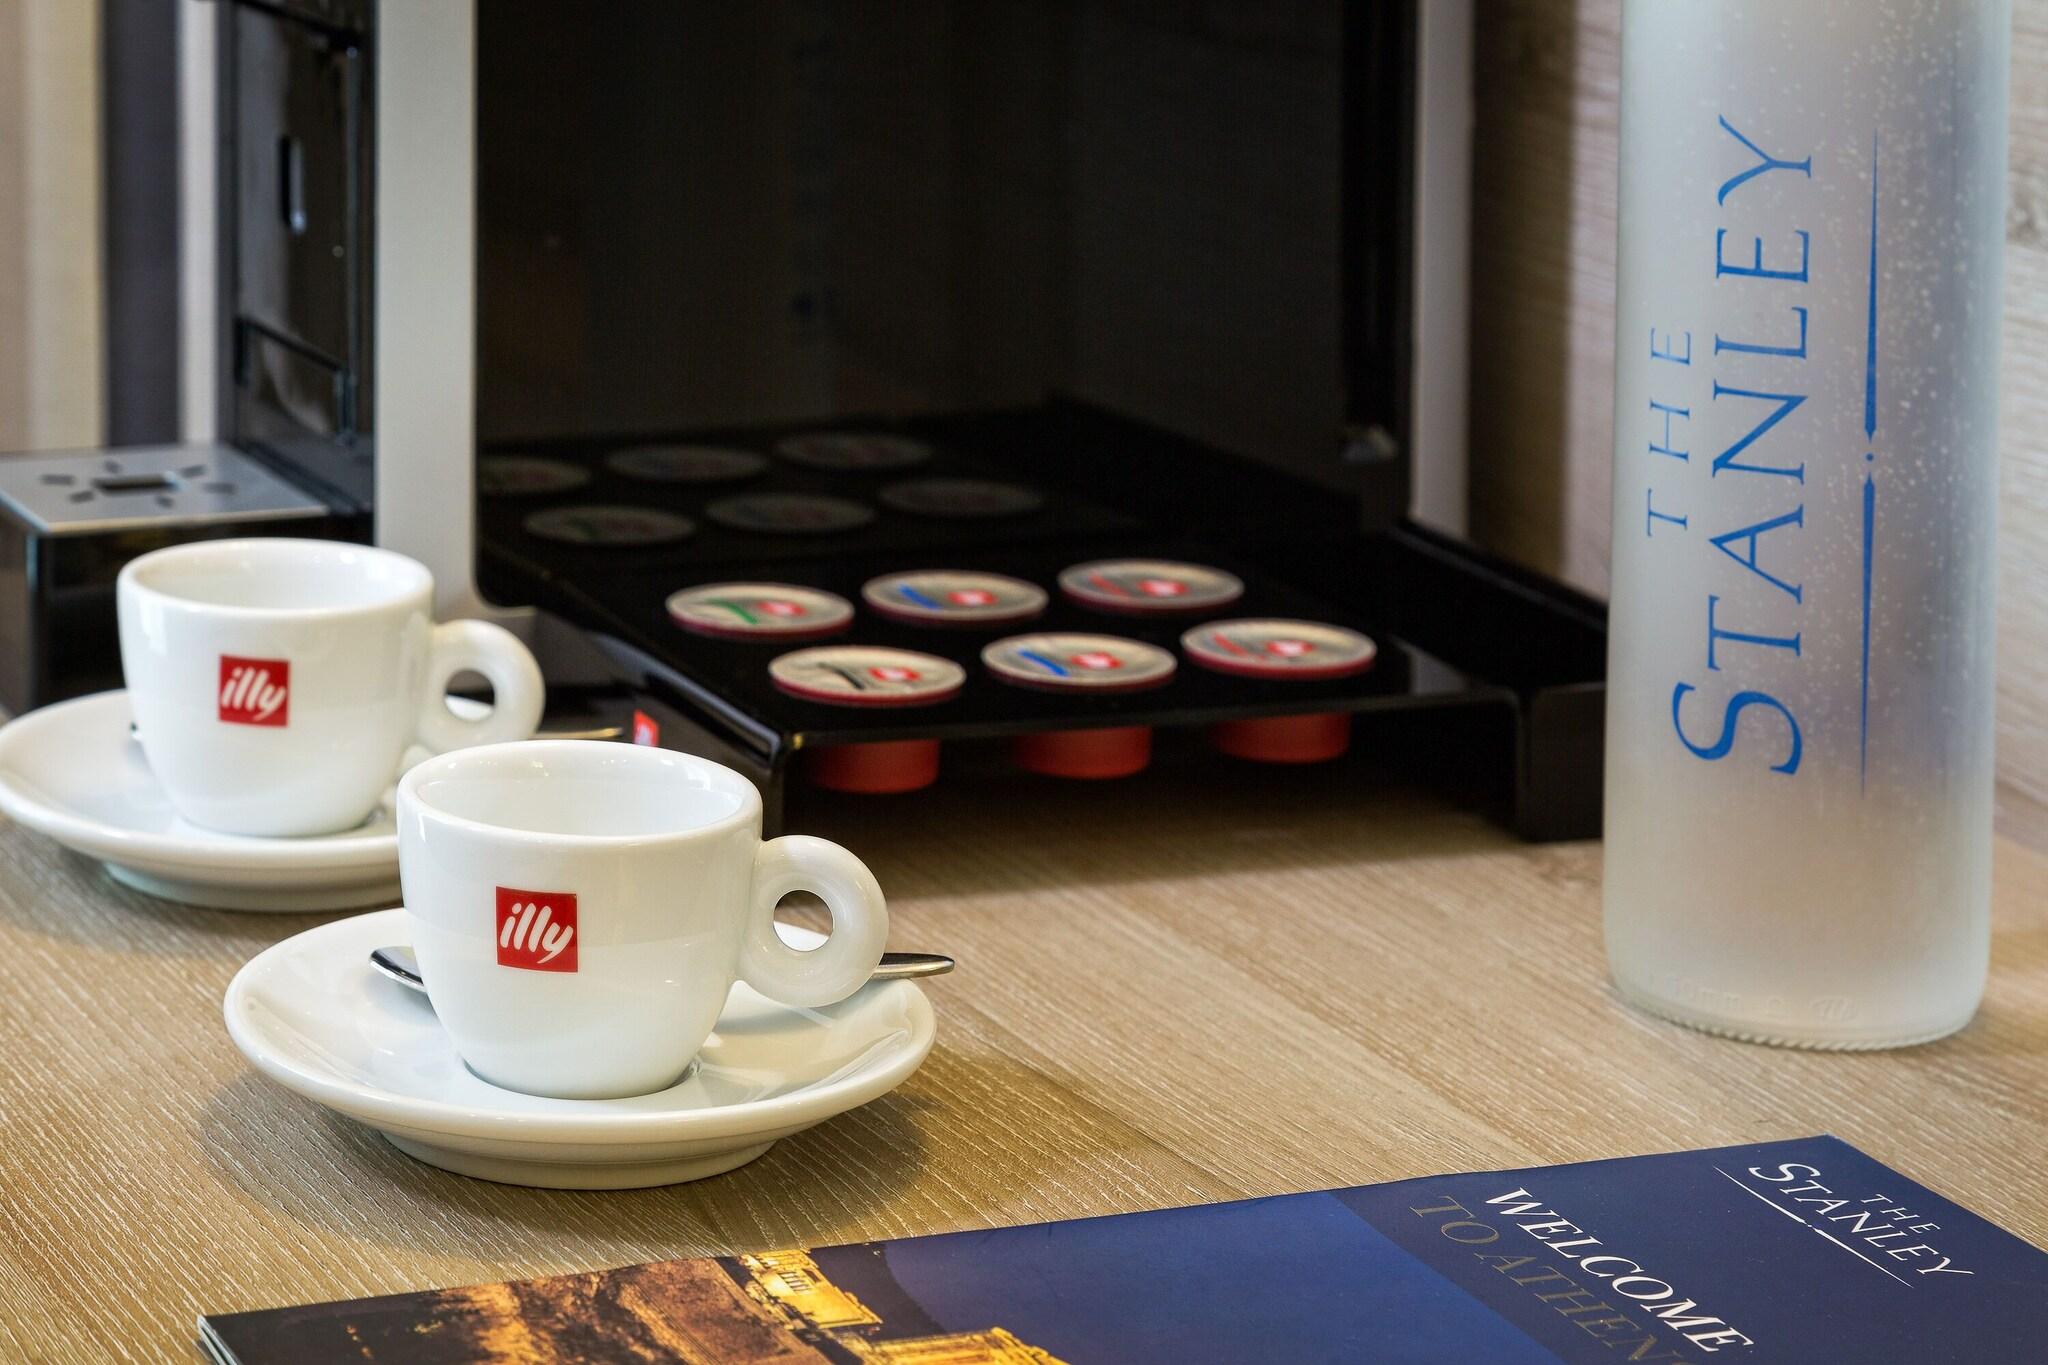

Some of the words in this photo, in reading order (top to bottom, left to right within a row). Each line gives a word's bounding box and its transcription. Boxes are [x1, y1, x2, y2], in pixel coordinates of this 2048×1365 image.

[1646, 328, 1691, 537] THE
[1672, 114, 1812, 775] STANLEY
[222, 666, 286, 721] illy
[500, 903, 574, 964] illy
[1409, 1195, 1499, 1244] TO
[1474, 1252, 1690, 1365] ATHEN
[1485, 1187, 1754, 1352] WELCOME
[1748, 1163, 1975, 1275] STANLEY
[1861, 1194, 1941, 1234] THE
